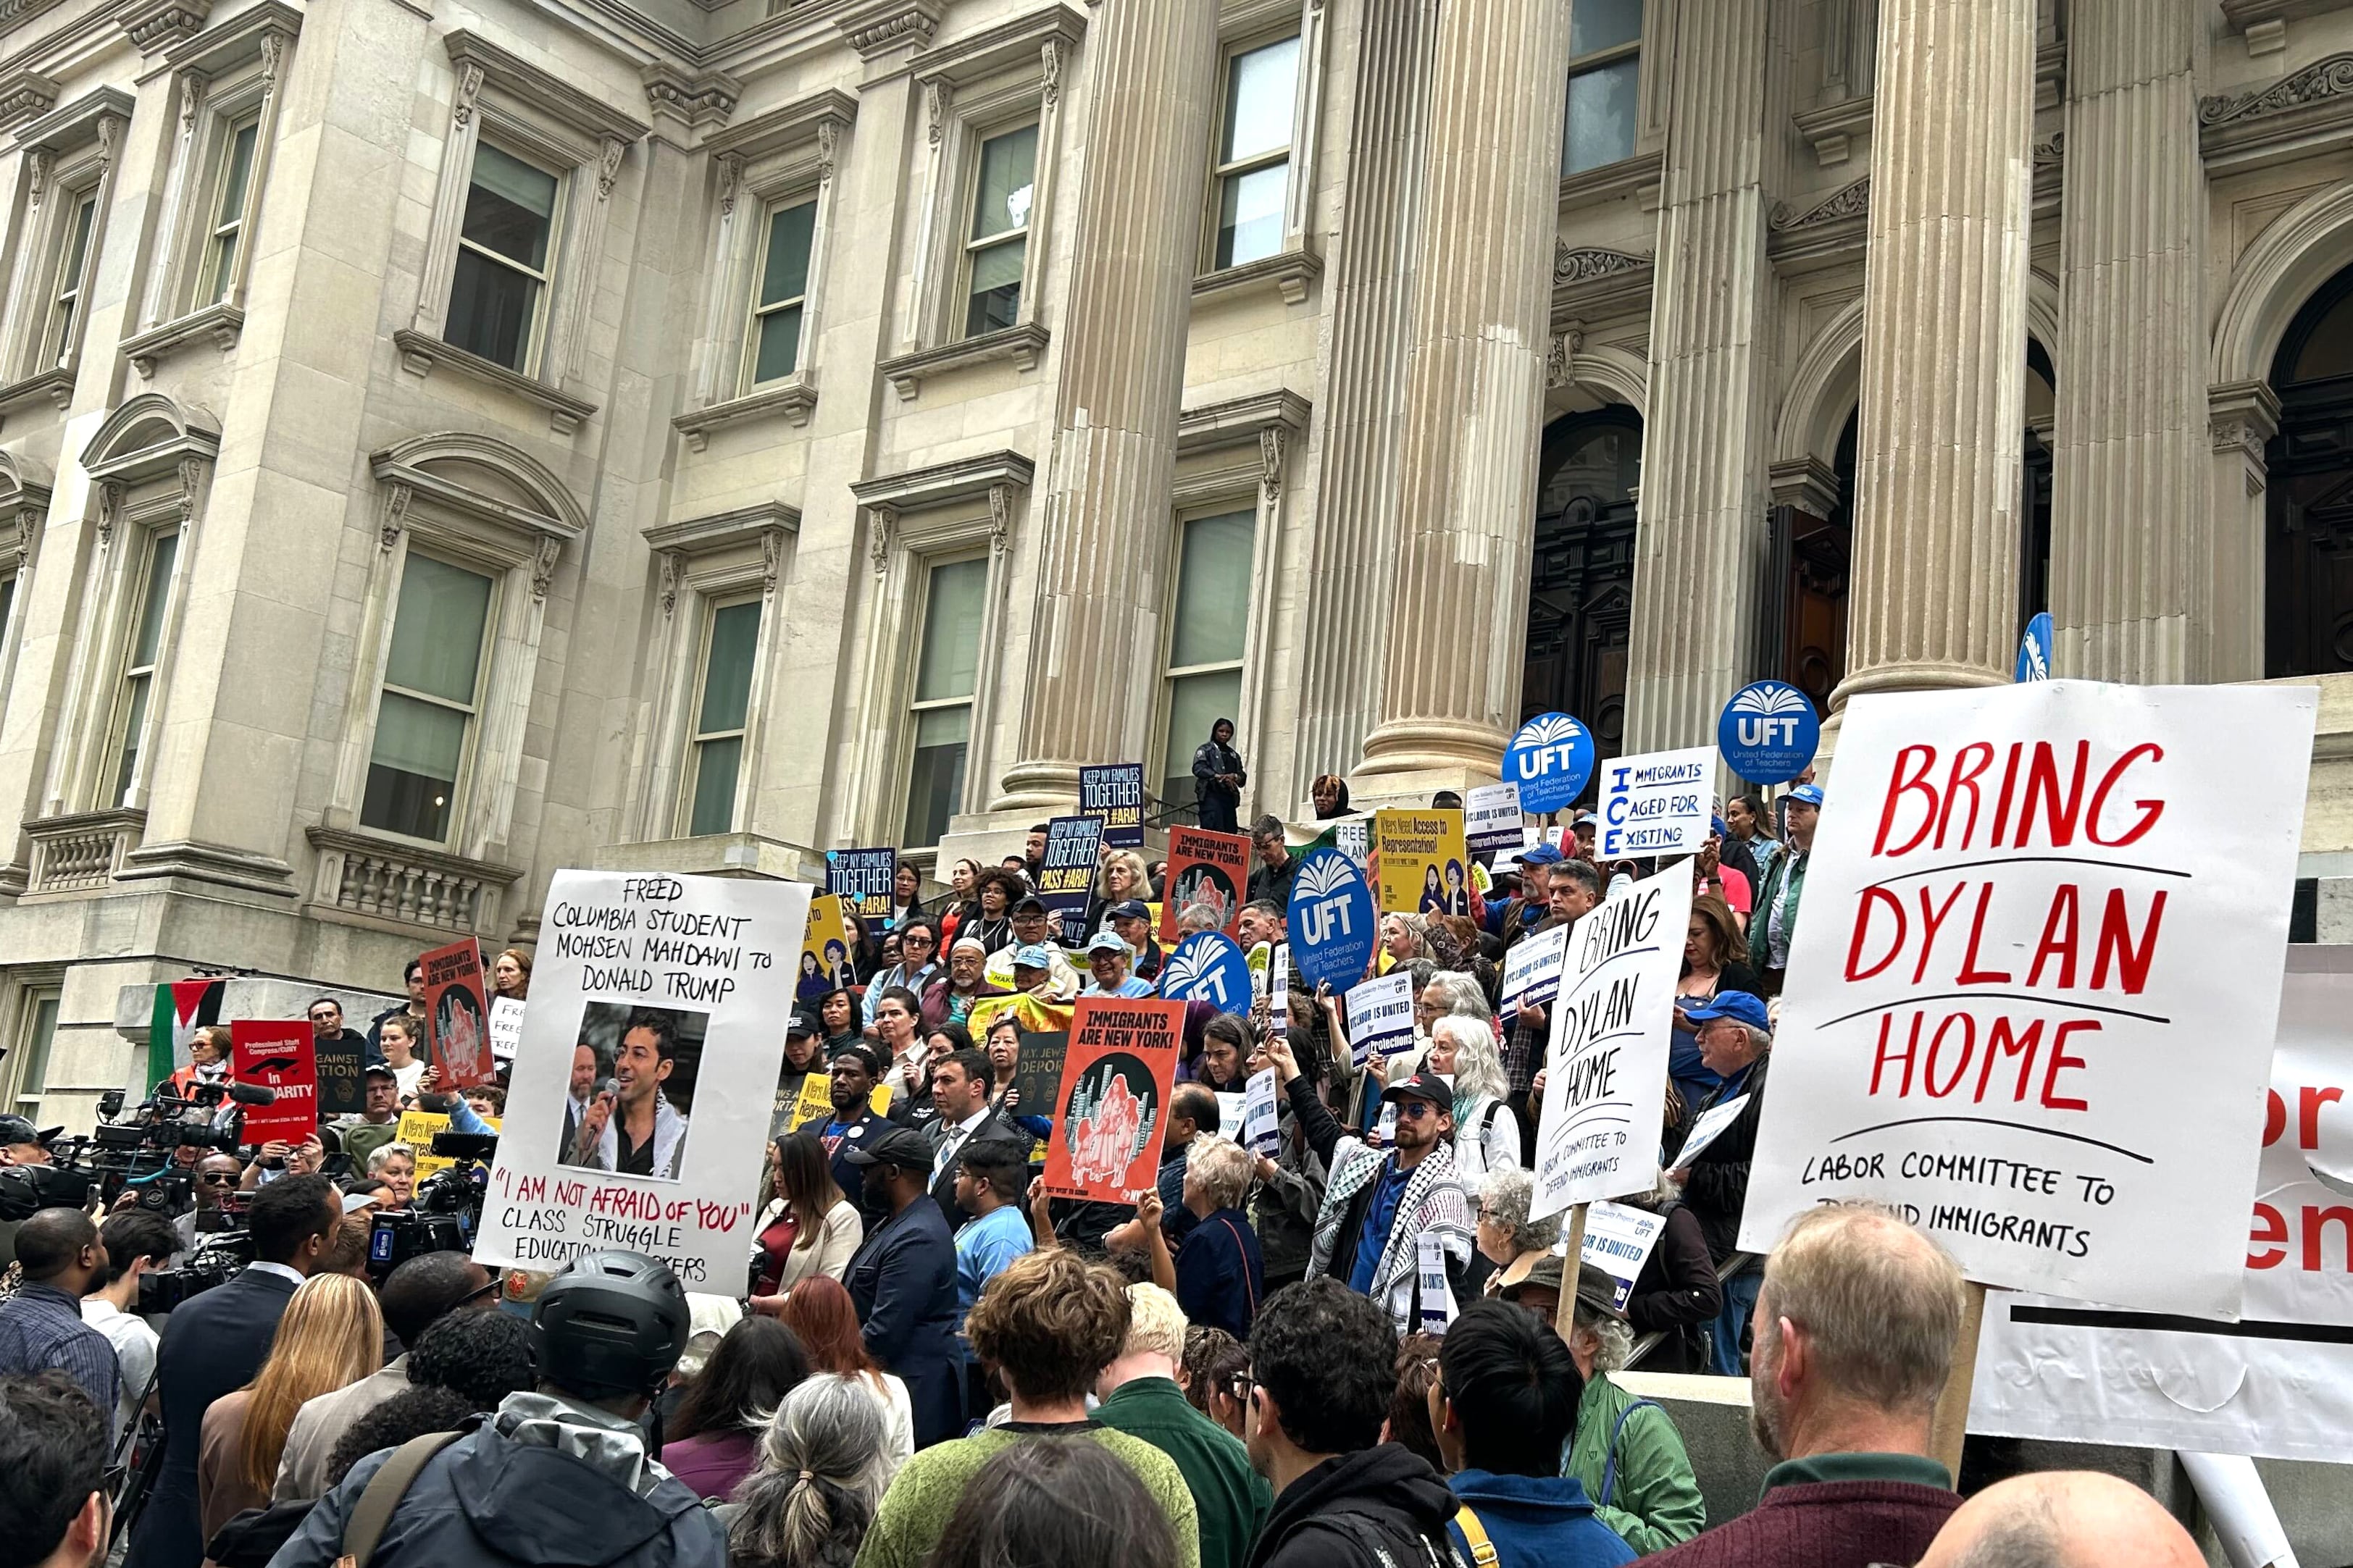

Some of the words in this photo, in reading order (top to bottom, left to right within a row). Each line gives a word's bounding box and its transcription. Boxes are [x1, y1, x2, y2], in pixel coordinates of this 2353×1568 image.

[1738, 718, 1799, 747] UFT
[1519, 742, 1574, 779] UFT
[1760, 750, 1804, 759] Federation
[1083, 769, 1100, 784] KEEP
[1101, 769, 1111, 783] NY
[1112, 767, 1140, 782] FAMILIES
[1540, 773, 1580, 787] Federation
[1084, 781, 1140, 808] TOGETHER
[1537, 784, 1571, 795] Teachers
[1871, 739, 2165, 858] BRING
[1474, 809, 1490, 822] LABOR
[1492, 809, 1497, 819] IS
[1498, 806, 1518, 818] UNITED
[1671, 795, 1699, 813] FOR
[1111, 808, 1140, 825] #ARA!
[1381, 817, 1397, 834] NYers
[1398, 818, 1412, 834] Need
[1413, 817, 1438, 834] Access
[1440, 818, 1447, 835] to
[1050, 822, 1067, 839] KEEP
[1066, 821, 1076, 838] NY
[1074, 819, 1101, 837] FAMILIES
[1337, 826, 1366, 841] FREE
[1492, 833, 1522, 845] Protections
[1045, 837, 1098, 867] TOGETHER
[1180, 834, 1239, 854] IMMIGRANTS
[1382, 836, 1437, 855] Representation!
[850, 853, 860, 868] NY
[861, 852, 891, 868] FAMILIES
[1175, 844, 1192, 858] ARE
[1195, 848, 1214, 861] NEW
[1218, 852, 1244, 866] YORK!
[831, 868, 891, 895] TOGETHER
[1039, 869, 1063, 889] PASS
[1063, 868, 1092, 888] #ARA!
[623, 879, 683, 902] FREED
[812, 908, 822, 922] to
[859, 896, 890, 913] #ARA!
[553, 902, 636, 931] COLUMBIA
[647, 909, 752, 941] STUDENT
[1301, 894, 1352, 946] UFT
[1579, 888, 1660, 973] BRING
[1552, 937, 1562, 946] UFT
[1844, 881, 2168, 994] DYLAN
[428, 949, 471, 972] IMMIGRANTS
[556, 934, 632, 959] MOHSEN
[643, 937, 741, 970] MAHDAWI
[1303, 949, 1322, 966] United
[1324, 940, 1364, 957] Federation
[428, 973, 440, 986] ARE
[441, 967, 456, 983] NEW
[457, 961, 478, 977] YORK!
[1313, 963, 1319, 974] of
[1320, 955, 1355, 970] Teachers
[1506, 970, 1515, 985] NYC
[1516, 963, 1531, 980] LABOR
[1534, 959, 1539, 971] IS
[1539, 952, 1561, 968] UNITED
[582, 965, 653, 991] DONALD
[664, 972, 735, 1003] TRUMP
[1087, 1010, 1169, 1030] IMMIGRANTS
[1357, 1010, 1371, 1026] LABOR
[1374, 1007, 1381, 1019] IS
[1382, 1001, 1410, 1018] UNITED
[1560, 973, 1639, 1057] DYLAN
[245, 1039, 283, 1049] Professional
[1078, 1028, 1102, 1046] ARE
[1104, 1030, 1133, 1047] NEW
[1136, 1031, 1174, 1049] YORK!
[1371, 1034, 1413, 1052] Protections
[316, 1055, 359, 1064] GAINST
[1022, 1049, 1039, 1059] N.Y.
[1869, 1011, 2102, 1111] HOME
[268, 1073, 280, 1083] In
[1564, 1047, 1621, 1112] HOME
[403, 1119, 425, 1138] NYers
[1540, 1152, 1559, 1182] LABOR
[1563, 1133, 1610, 1160] COMMITTEE
[1614, 1131, 1626, 1145] TO
[1546, 1172, 1569, 1199] DEFEND
[1569, 1157, 1619, 1181] IMMIGRANTS
[1802, 1153, 1884, 1184] LABOR
[1901, 1152, 2061, 1195] COMMITTEE
[2077, 1175, 2114, 1205] TO
[516, 1175, 546, 1204] AM
[553, 1179, 588, 1209] NOT
[590, 1186, 661, 1221] AFRAID
[665, 1201, 693, 1223] OF
[1616, 1212, 1636, 1223] Project
[501, 1207, 567, 1233] CLASS
[582, 1214, 681, 1254] STRUGGLE
[1634, 1227, 1651, 1238] UFT
[1928, 1204, 2090, 1257] IMMIGRANTS
[1596, 1236, 1608, 1252] IS
[1606, 1239, 1643, 1262] UNITED
